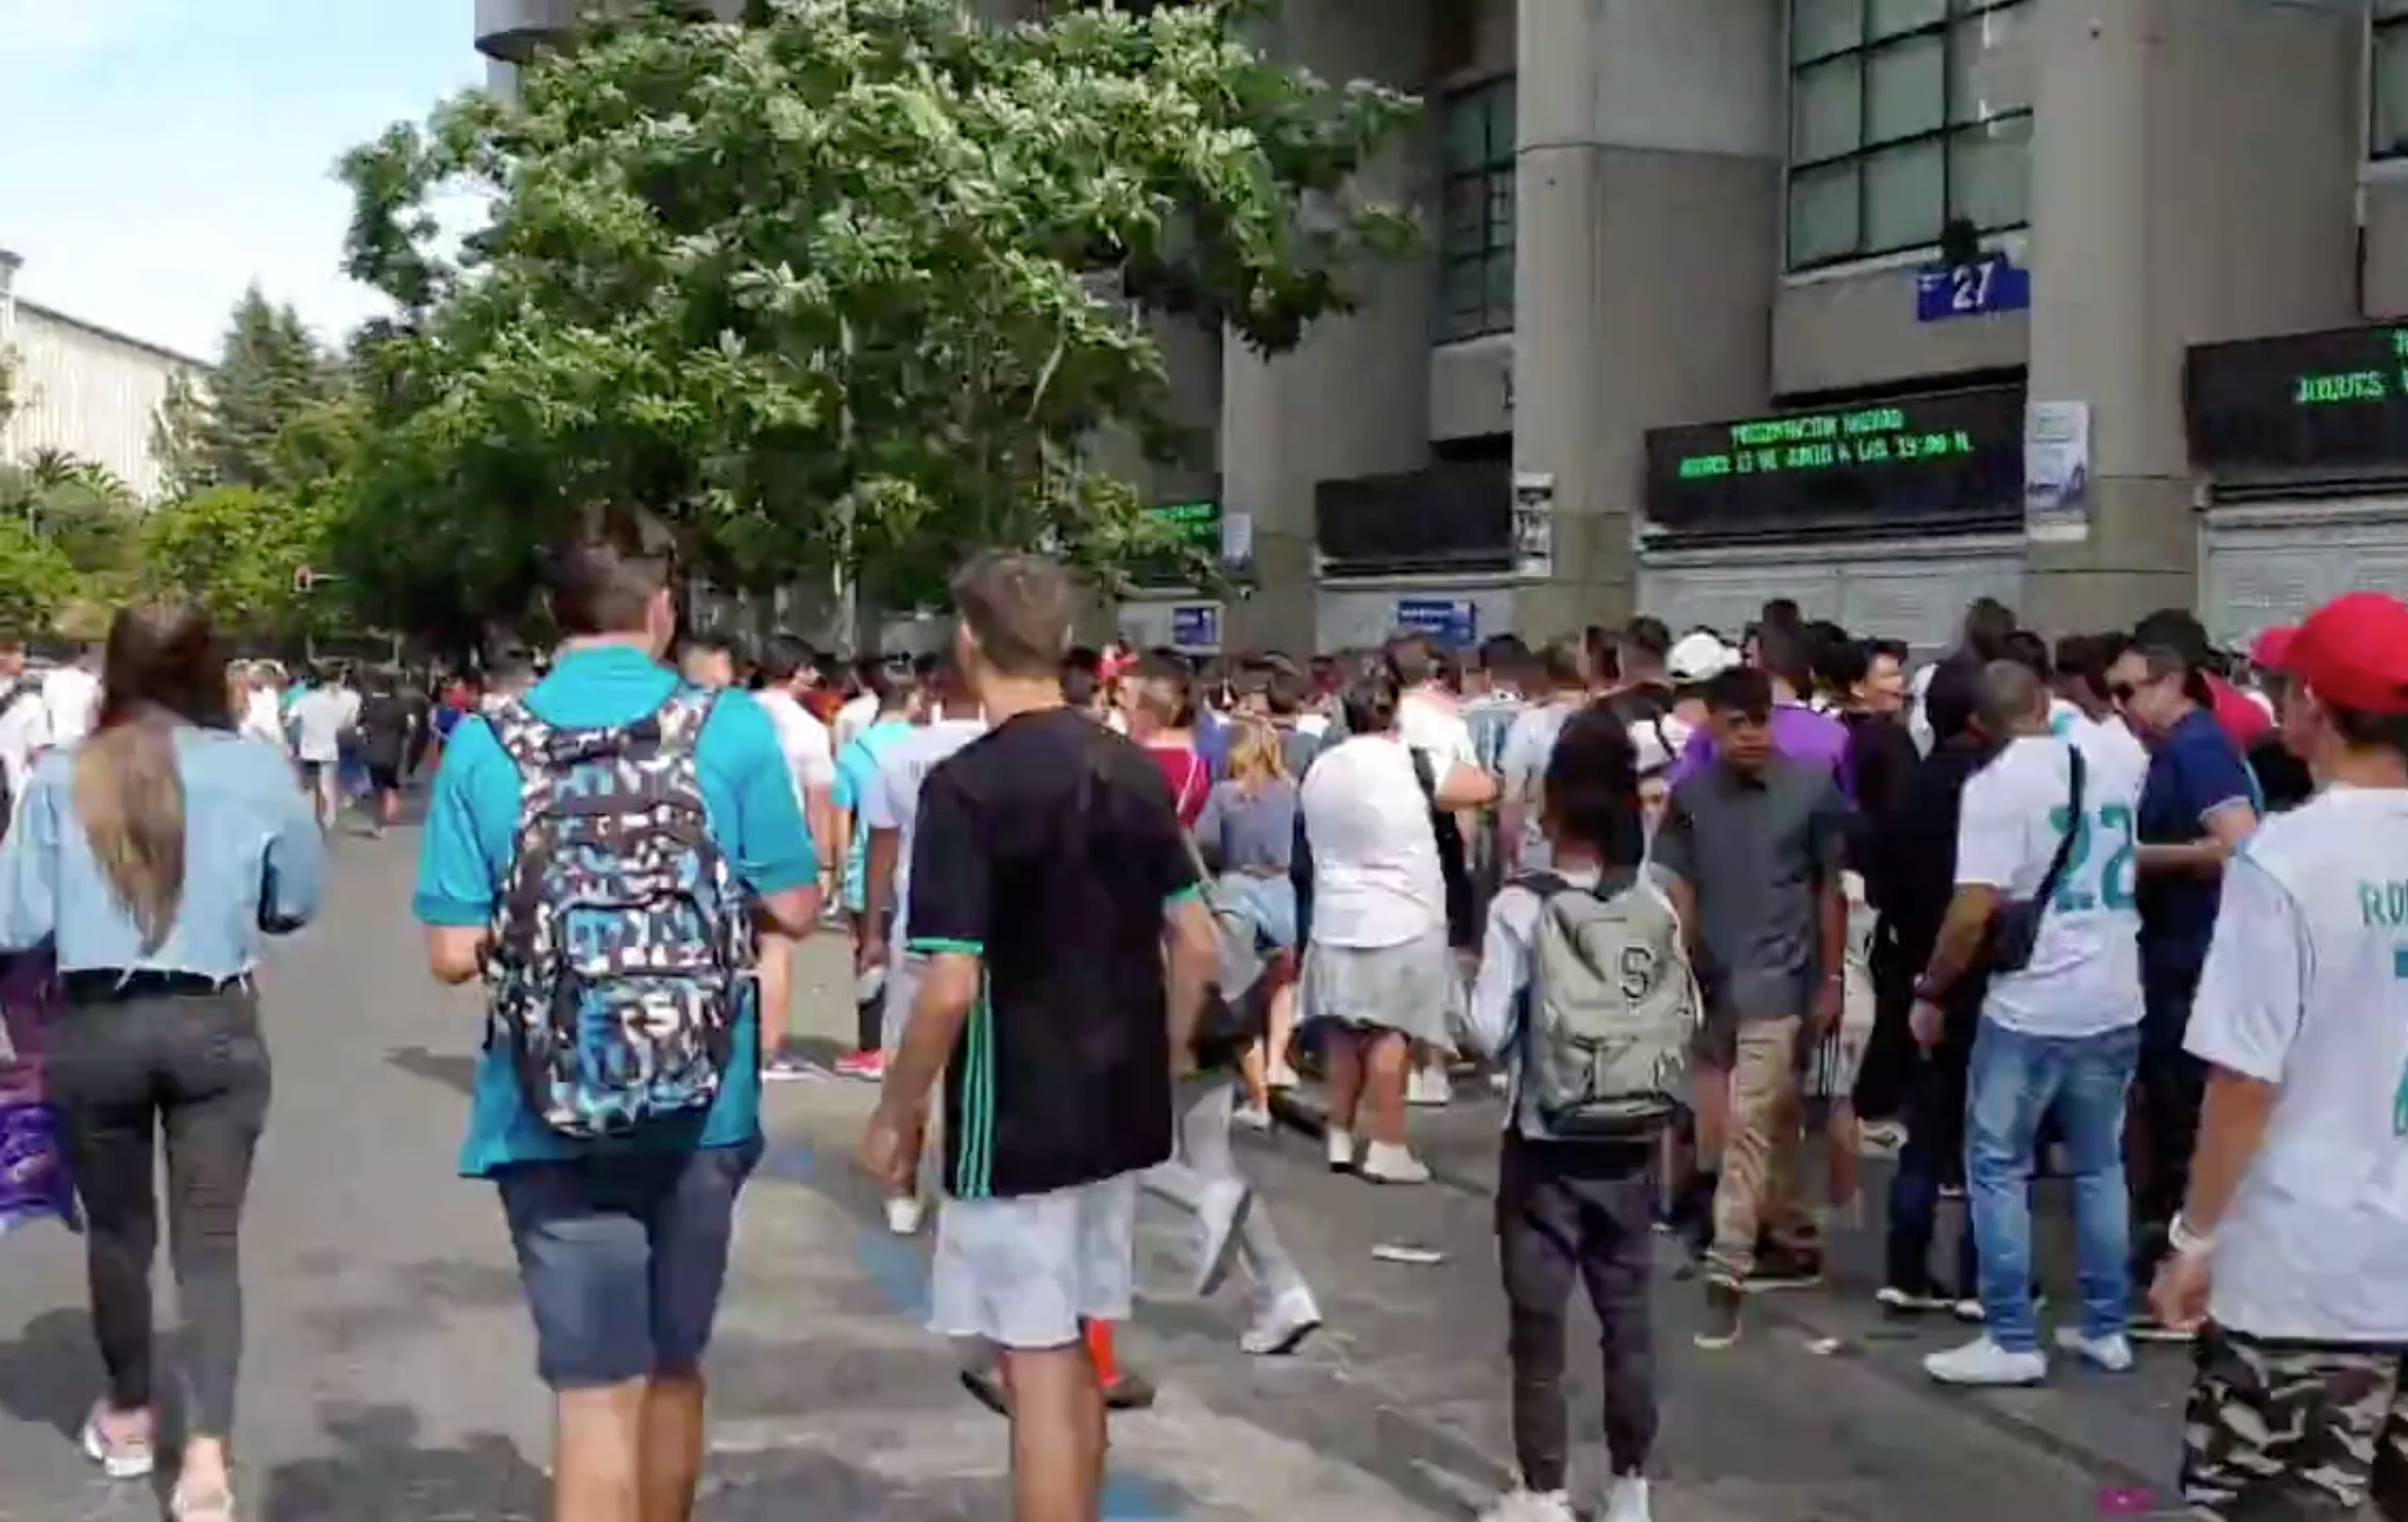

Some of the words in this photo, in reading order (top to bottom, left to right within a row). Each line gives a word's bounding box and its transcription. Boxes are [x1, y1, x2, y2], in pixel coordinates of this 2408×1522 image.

[1951, 260, 1995, 309] 27
[2048, 805, 2136, 912] 22
[2355, 879, 2408, 926] RO
